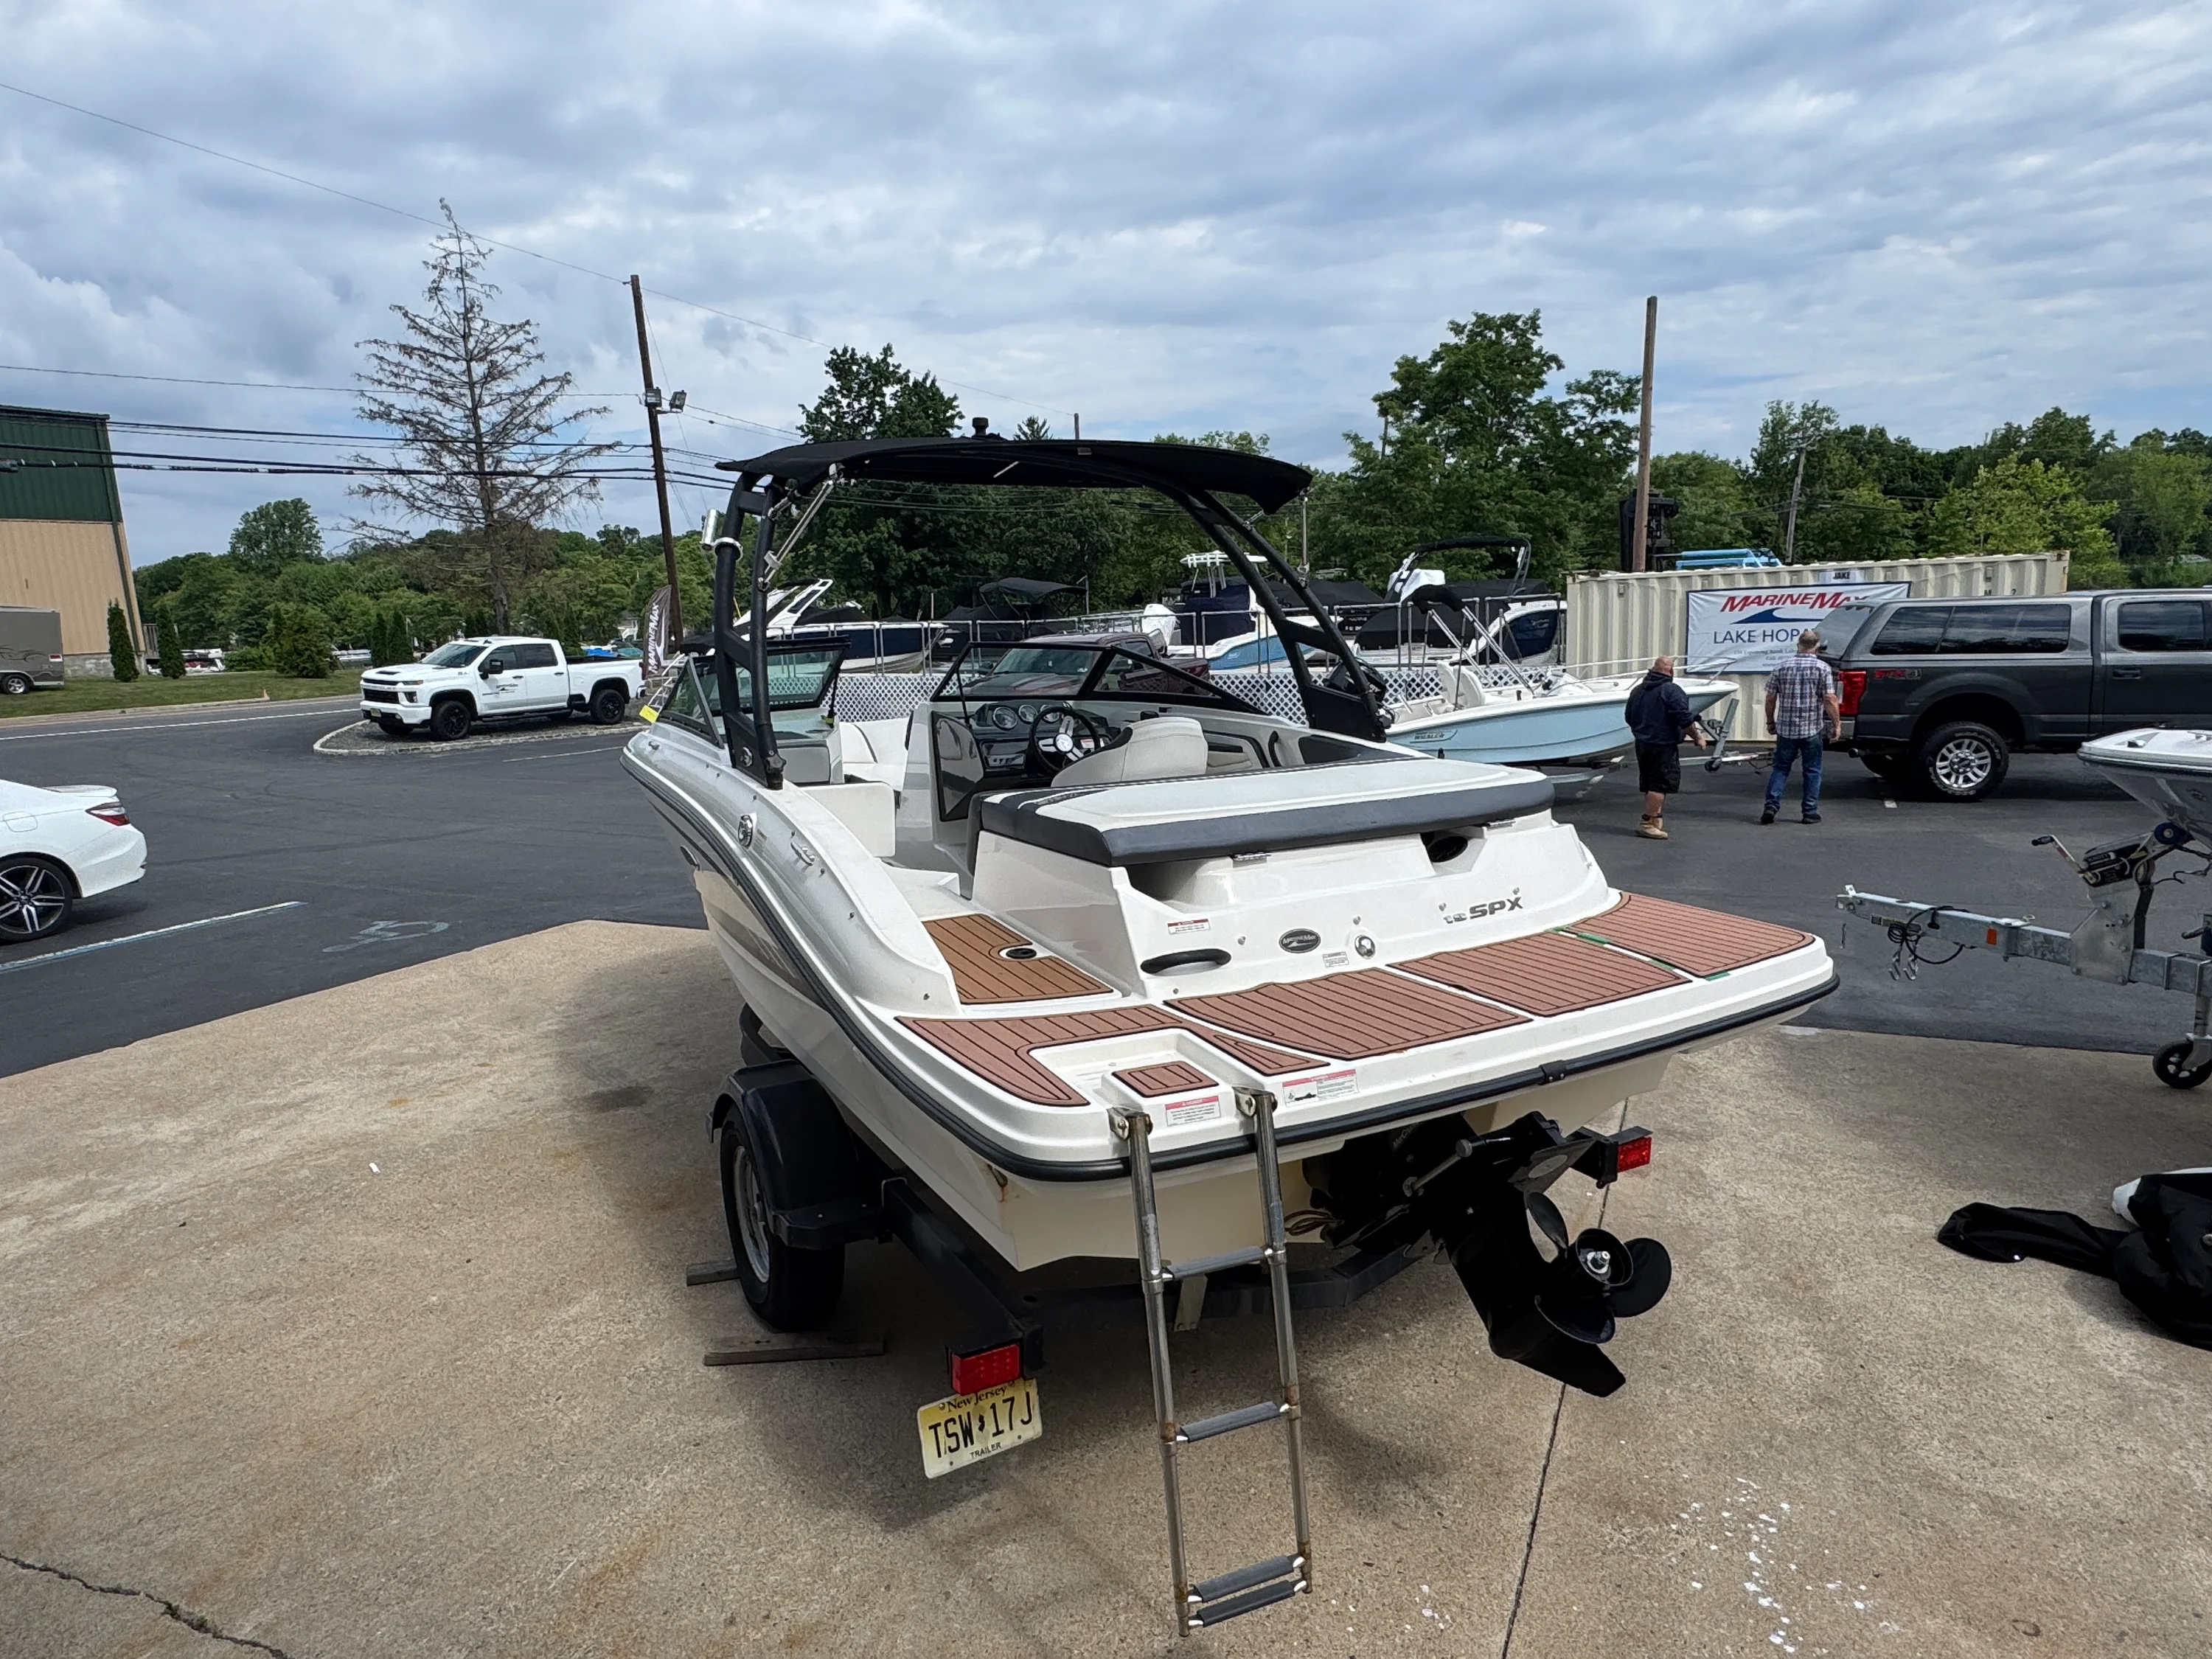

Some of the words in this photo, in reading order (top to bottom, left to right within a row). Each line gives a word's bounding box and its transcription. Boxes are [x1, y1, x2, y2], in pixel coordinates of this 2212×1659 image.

[1714, 629, 1756, 644] LAKE
[1470, 897, 1523, 919] SPX
[947, 1396, 973, 1413] New
[974, 1385, 1007, 1405] Jersey
[928, 1411, 975, 1458] TSW
[990, 1391, 1033, 1438] 17J
[970, 1441, 1003, 1460] TRAILER
